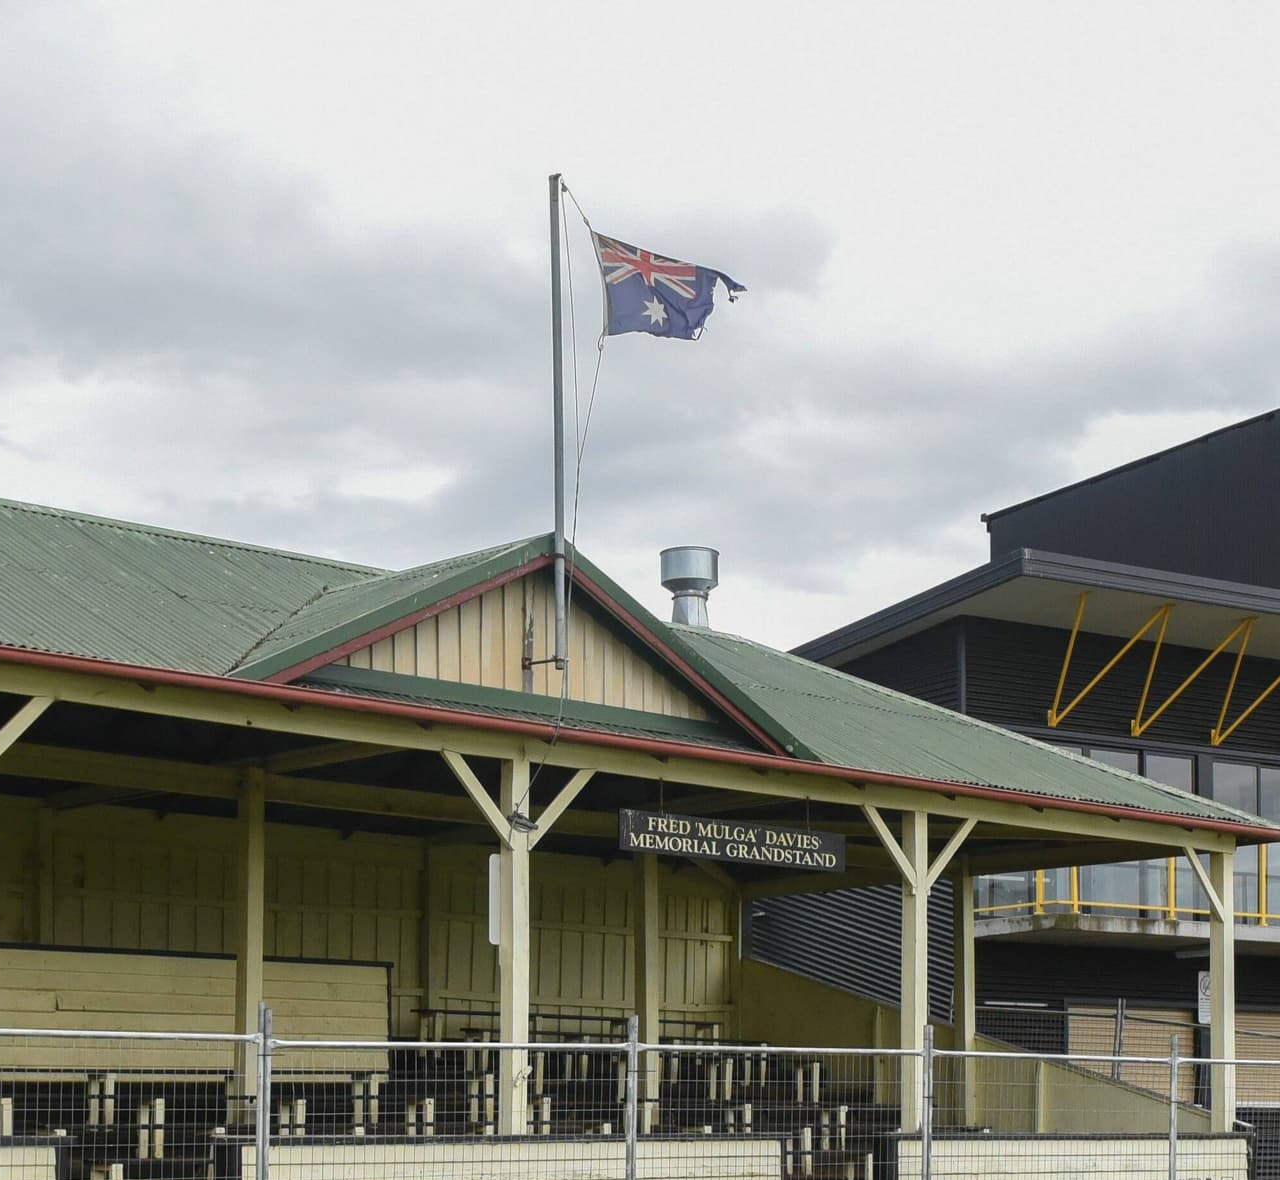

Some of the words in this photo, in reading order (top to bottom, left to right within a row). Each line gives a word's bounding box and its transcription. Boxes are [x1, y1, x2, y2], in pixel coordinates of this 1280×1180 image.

[629, 832, 721, 856] MEMORIAL
[726, 843, 837, 868] GRANDSTAND
[647, 816, 691, 835] FRED
[765, 830, 820, 850] DAVIES
